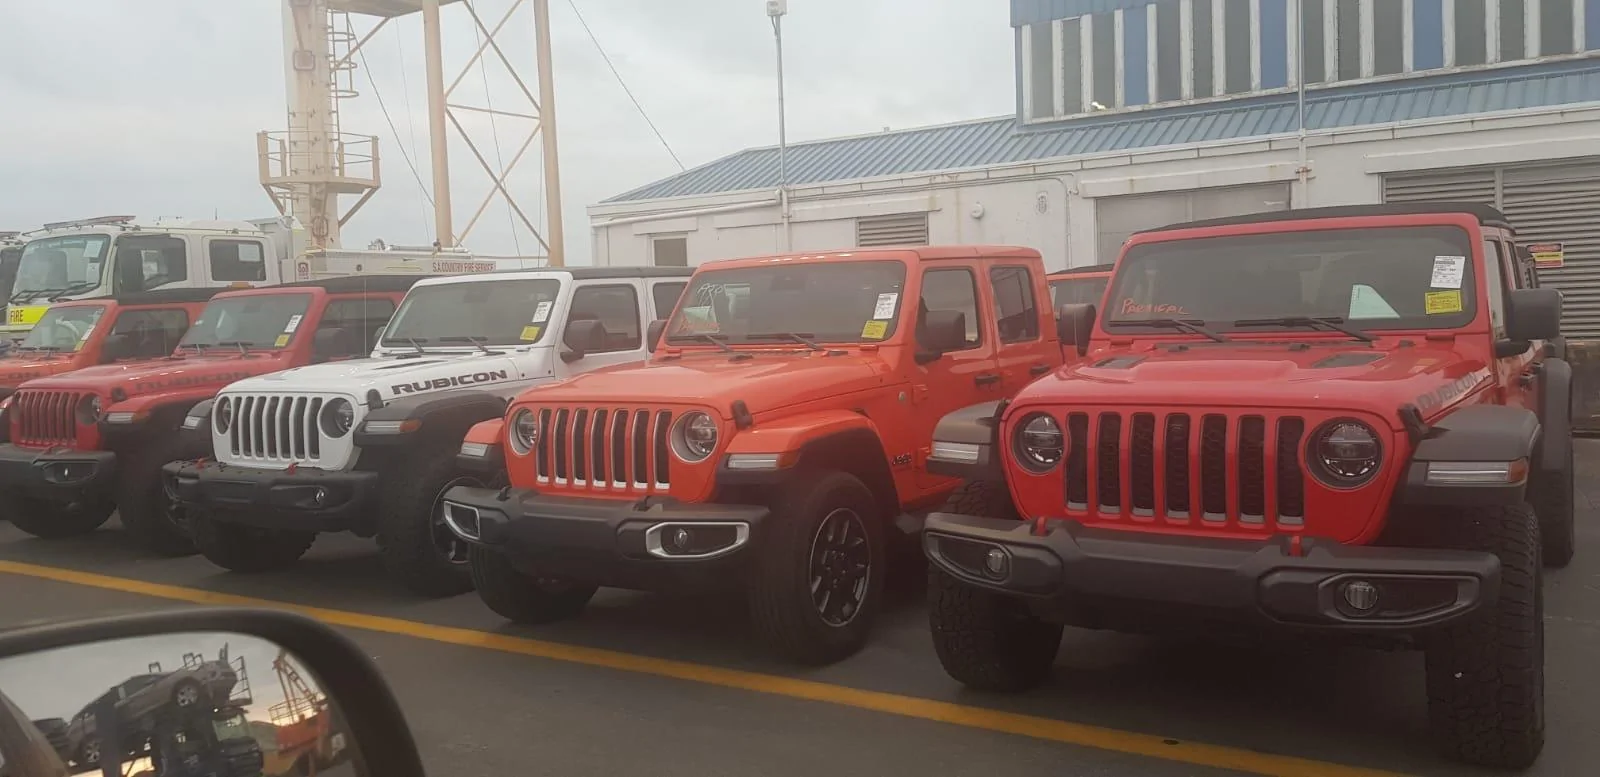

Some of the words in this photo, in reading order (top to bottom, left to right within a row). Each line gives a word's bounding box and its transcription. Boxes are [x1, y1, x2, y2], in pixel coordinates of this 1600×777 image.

[442, 262, 463, 272] COUNTRY
[464, 262, 474, 272] FIRE
[475, 262, 494, 272] SERVICE
[10, 309, 24, 323] FIRE
[391, 370, 507, 395] RUBICON
[1417, 372, 1478, 409] RUBICON
